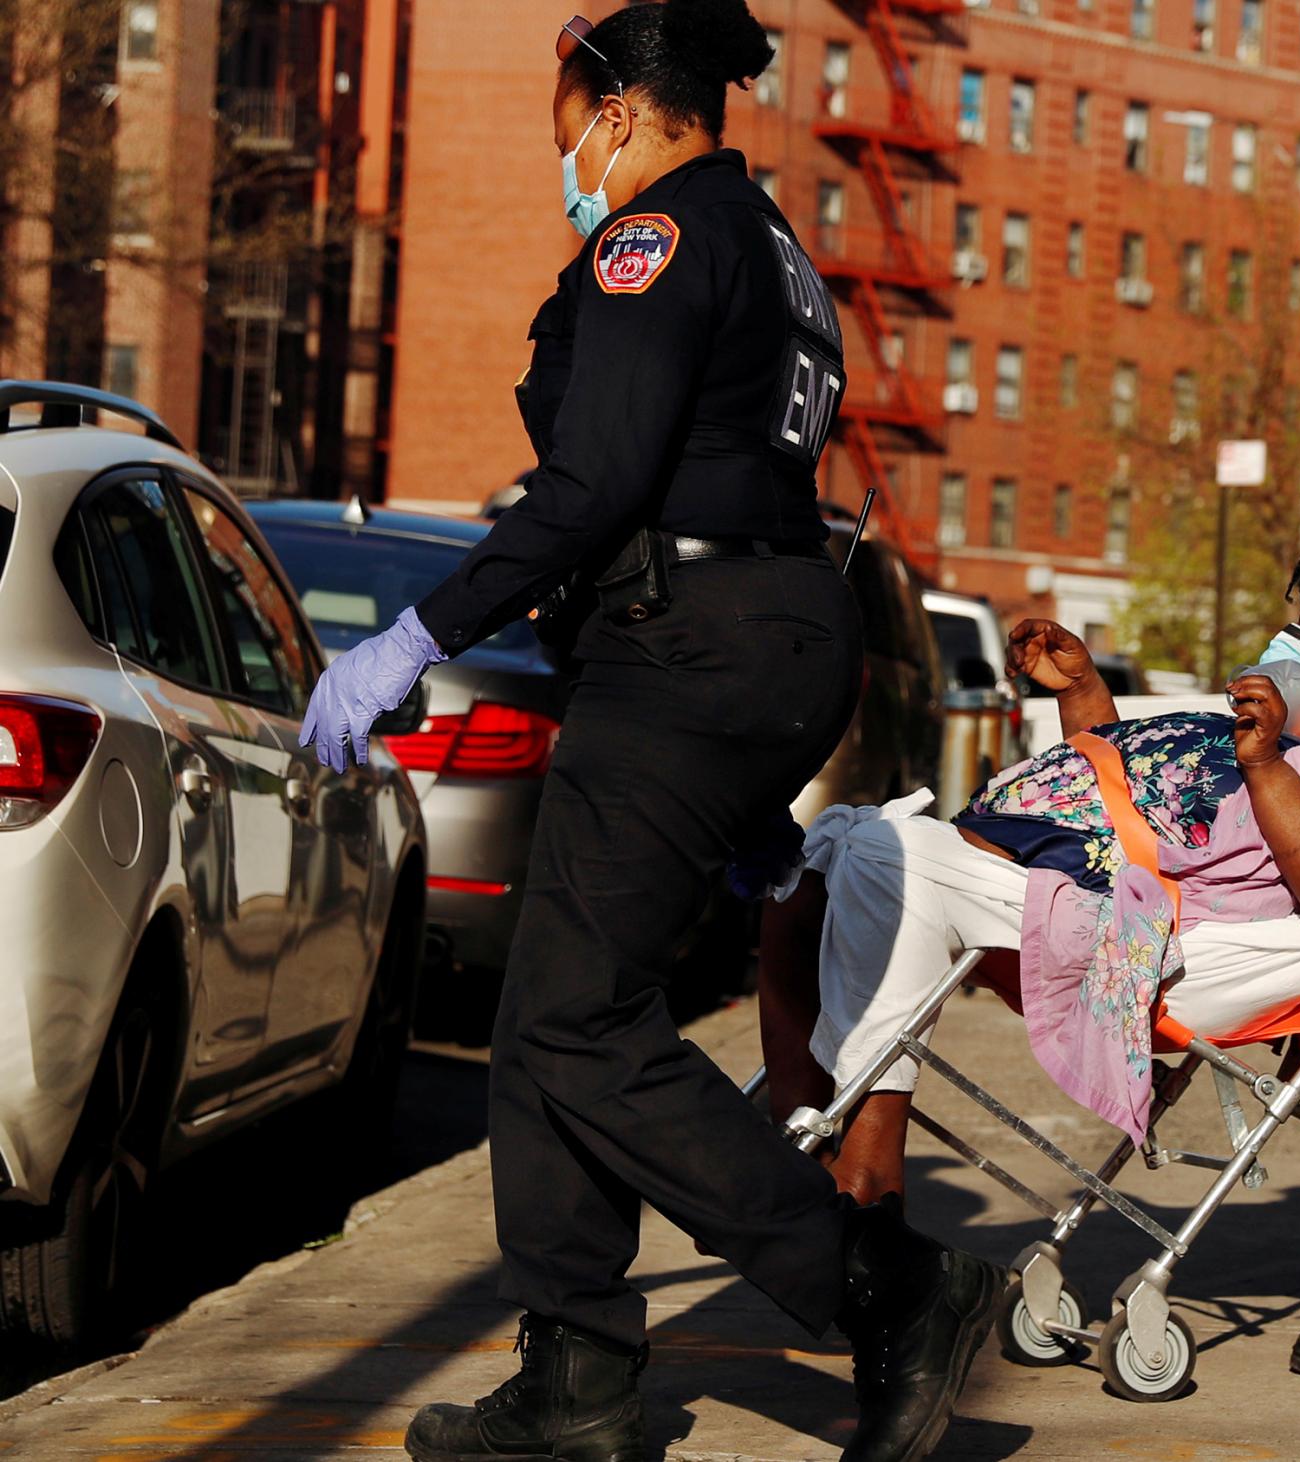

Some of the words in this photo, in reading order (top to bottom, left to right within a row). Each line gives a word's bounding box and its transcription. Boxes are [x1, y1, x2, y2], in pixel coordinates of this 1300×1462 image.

[623, 228, 642, 236] CITY
[642, 227, 654, 235] OF
[624, 219, 672, 238] DEPARTMENT
[616, 234, 635, 242] NEW
[636, 233, 658, 241] YORK
[781, 350, 840, 462] EMT
